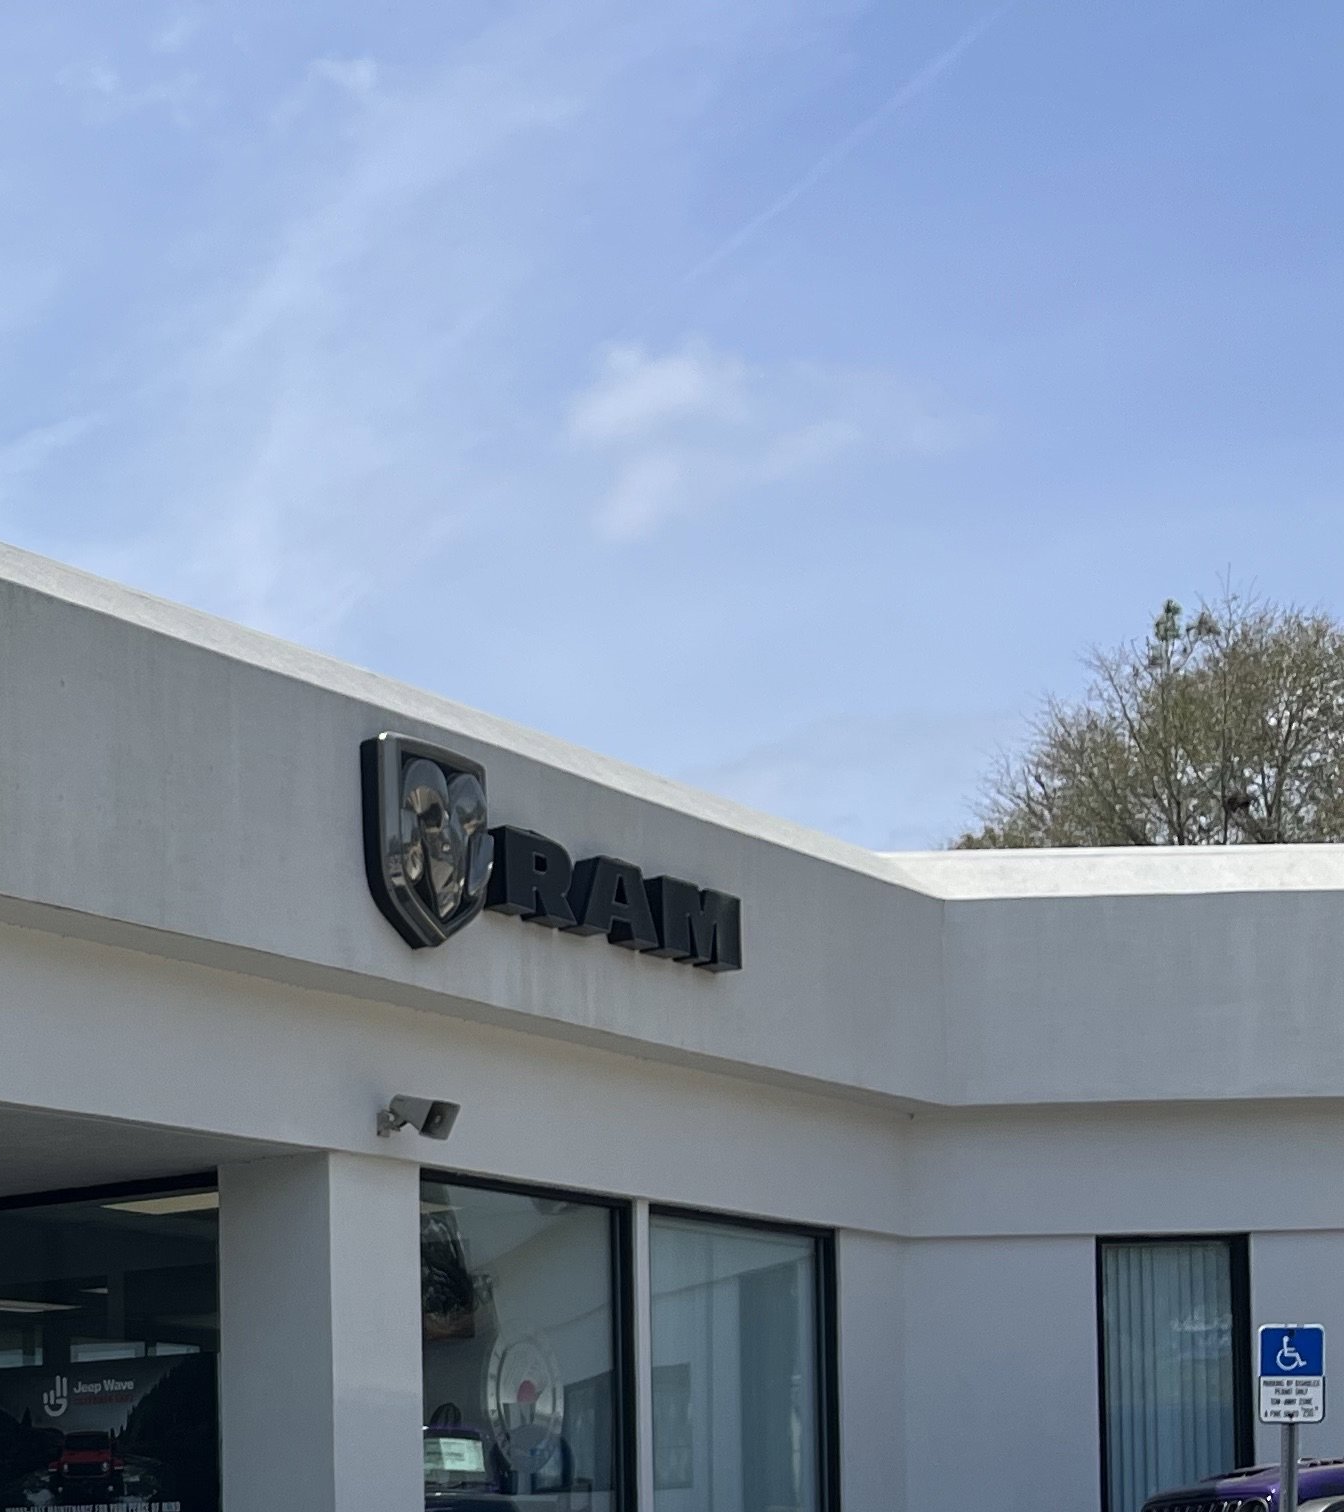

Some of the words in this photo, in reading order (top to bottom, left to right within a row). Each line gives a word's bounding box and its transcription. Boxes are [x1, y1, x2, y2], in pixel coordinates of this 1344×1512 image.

[485, 824, 743, 974] RAM
[73, 1381, 102, 1395] Jeep
[103, 1379, 134, 1391] Wave
